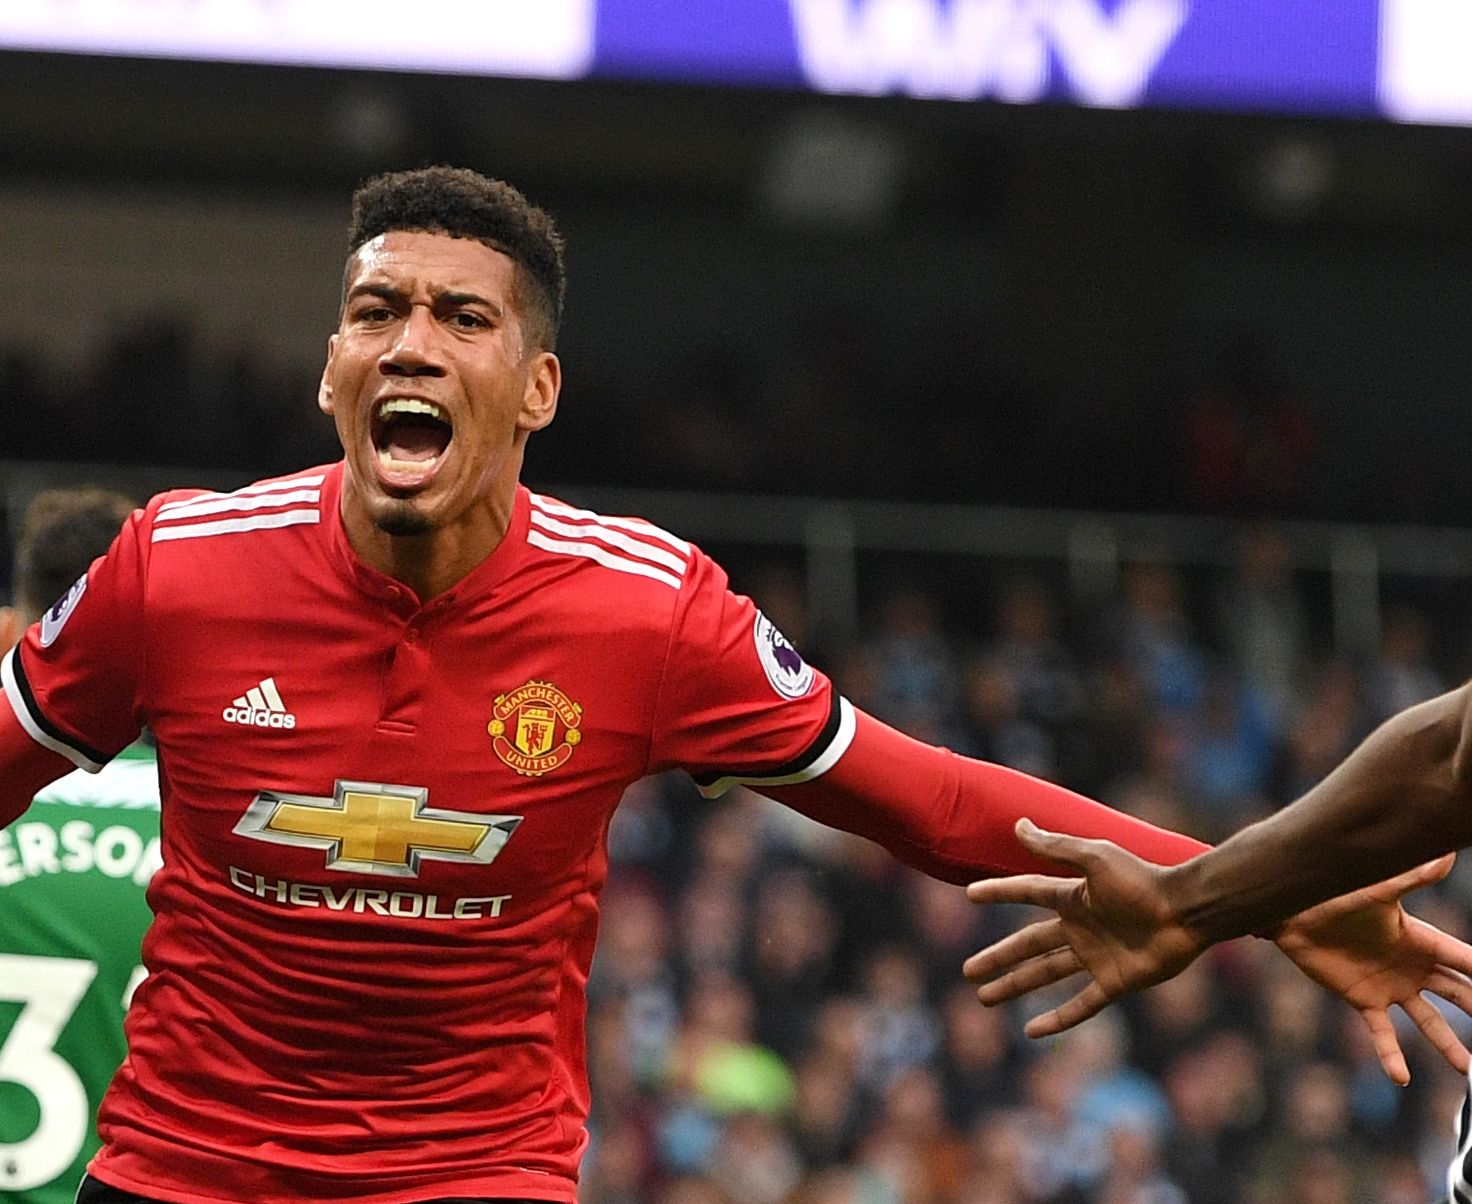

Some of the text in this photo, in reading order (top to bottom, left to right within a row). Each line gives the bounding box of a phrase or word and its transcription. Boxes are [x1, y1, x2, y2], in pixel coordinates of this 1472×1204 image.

[223, 704, 296, 729] adidas
[500, 687, 575, 722] MANCHESTER
[506, 750, 557, 769] UNITED
[228, 866, 512, 919] CHEVROLET
